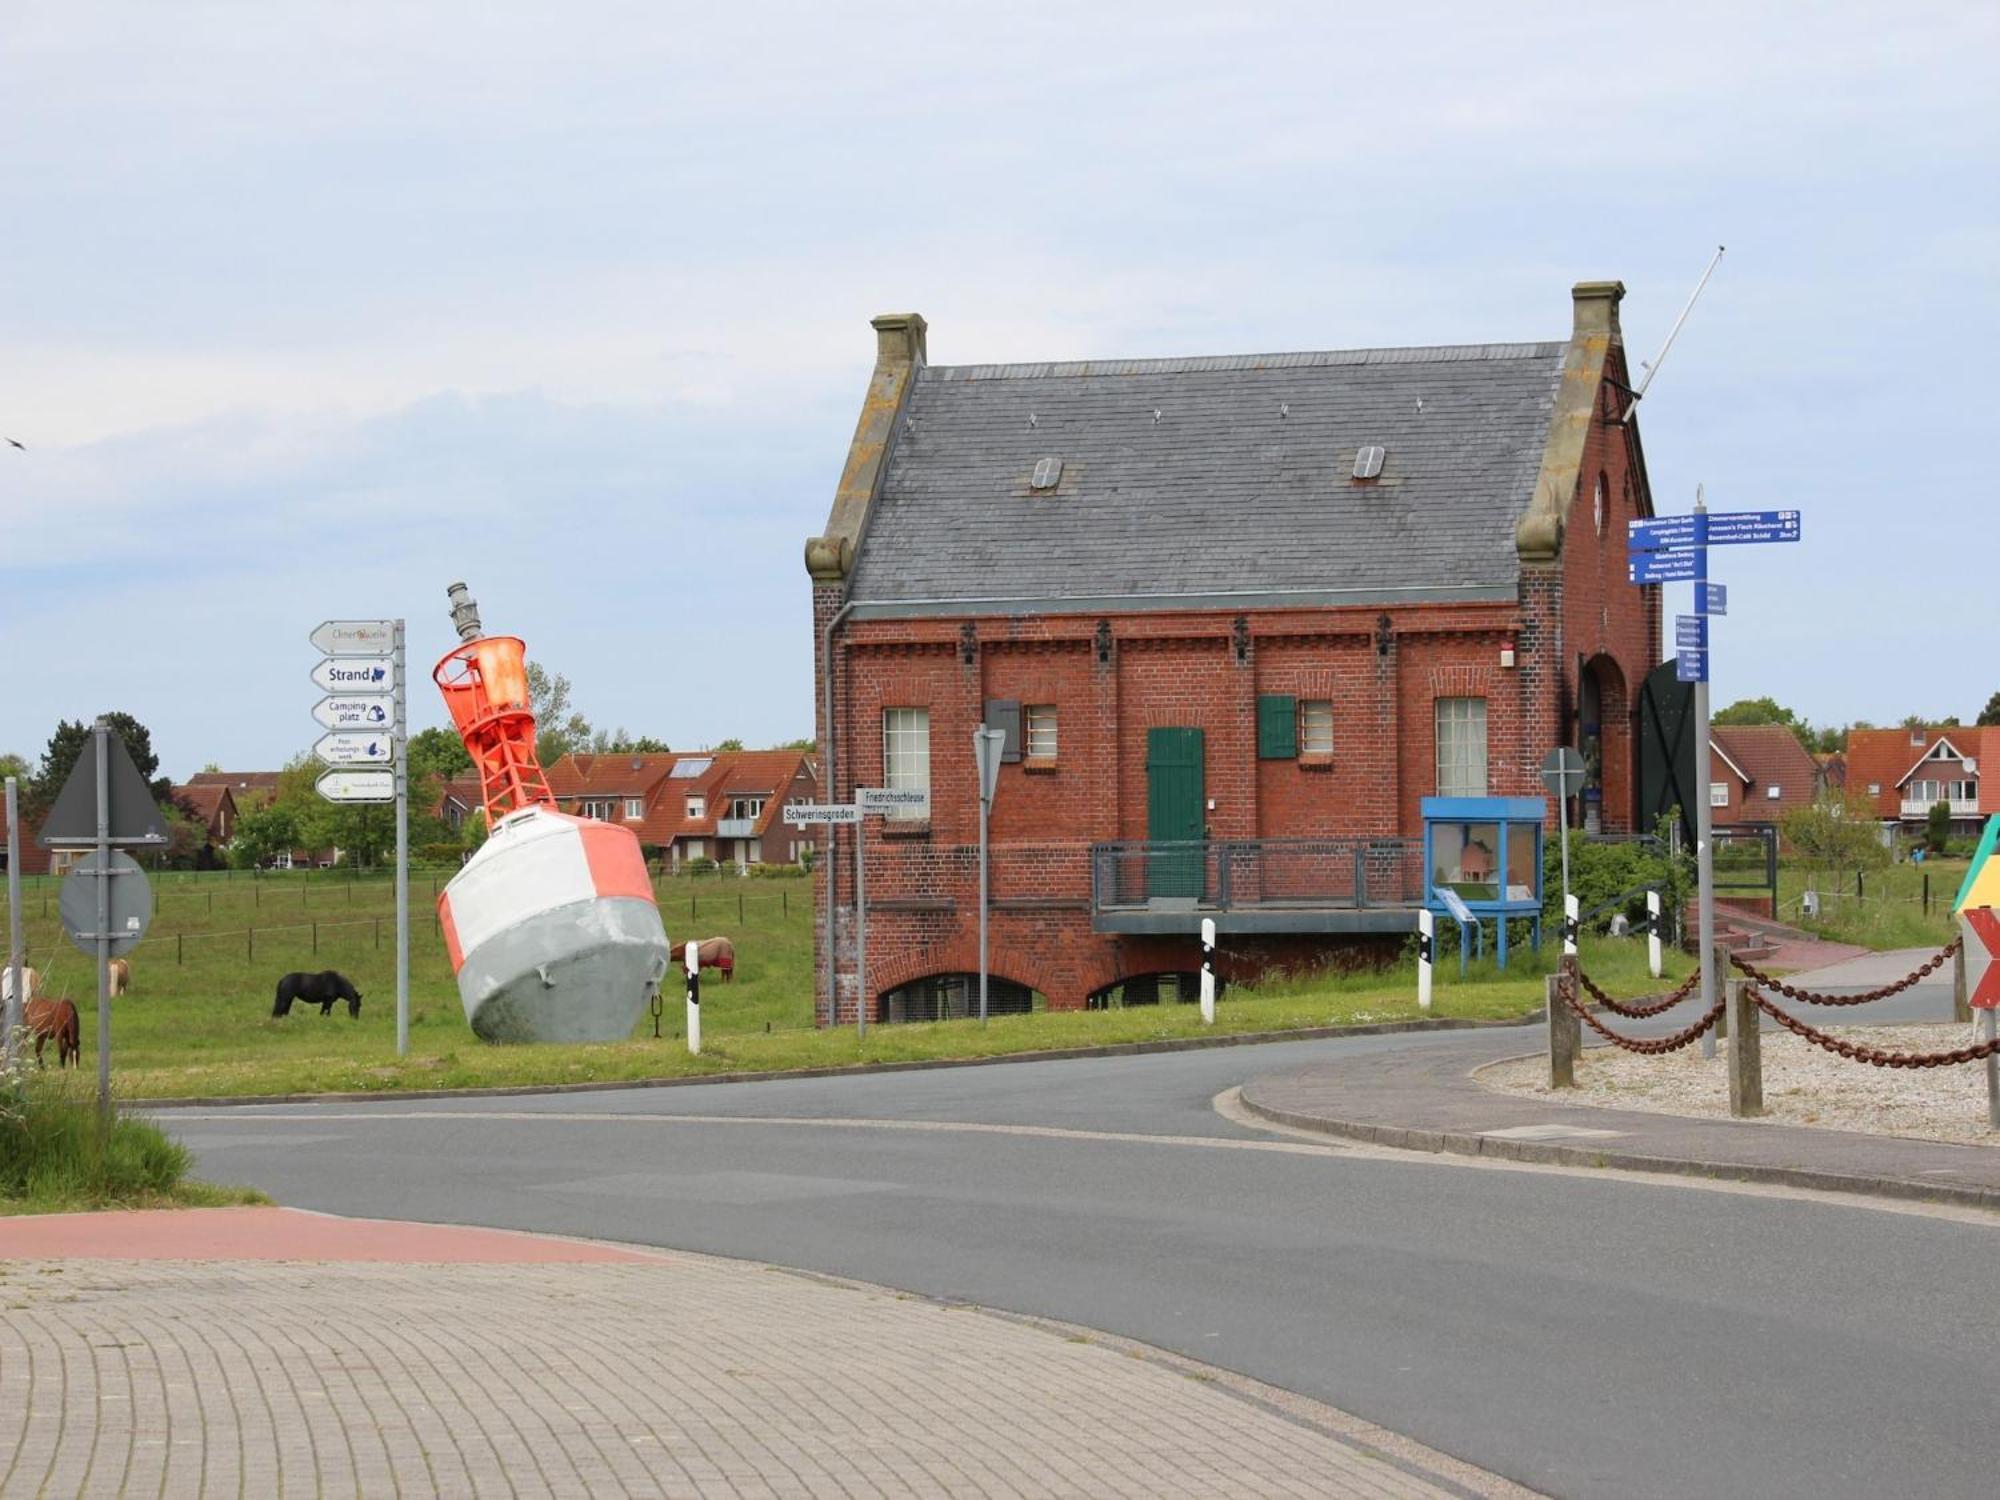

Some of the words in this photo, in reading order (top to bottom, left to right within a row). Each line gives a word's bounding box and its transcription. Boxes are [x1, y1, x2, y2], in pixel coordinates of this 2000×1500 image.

[329, 668, 370, 681] Strand
[329, 702, 366, 712] Camping
[340, 712, 360, 722] platz
